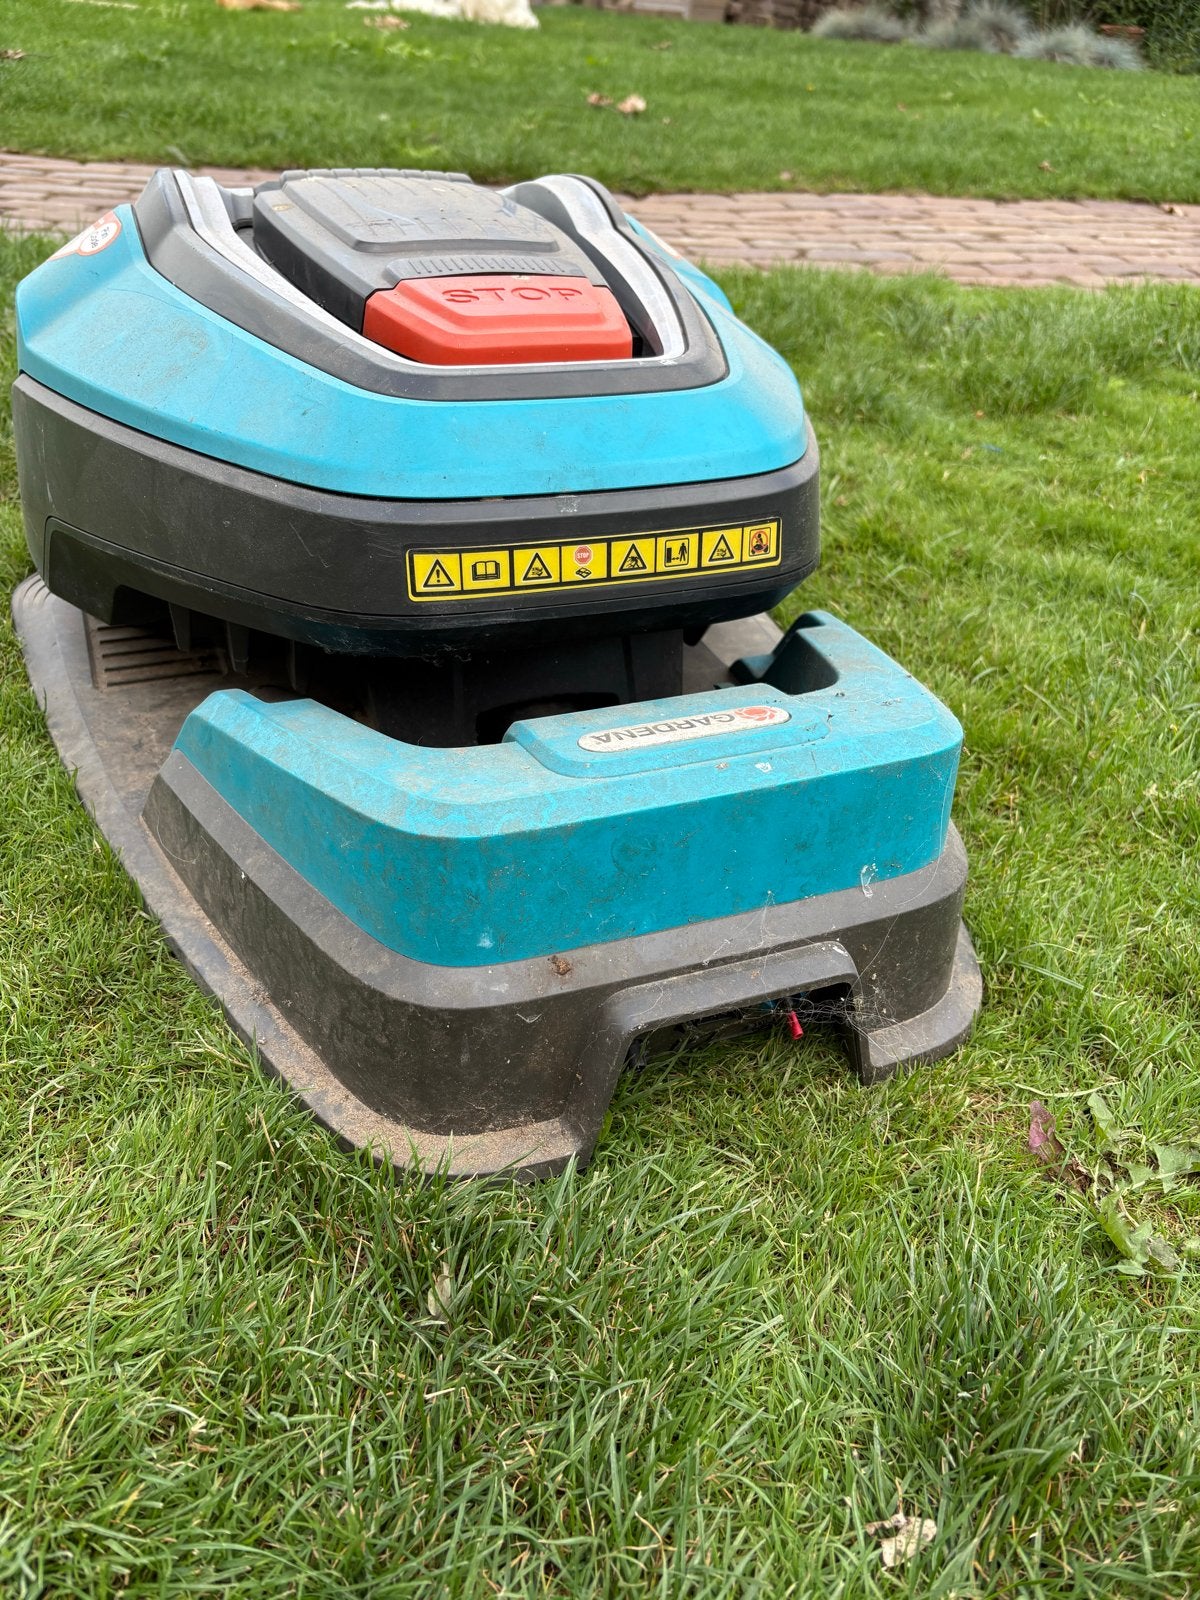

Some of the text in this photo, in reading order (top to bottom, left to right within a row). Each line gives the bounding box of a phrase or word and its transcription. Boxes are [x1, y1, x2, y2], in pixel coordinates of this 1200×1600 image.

[442, 287, 582, 303] STOP
[576, 551, 590, 560] STOP
[592, 713, 736, 743] GARDENA
